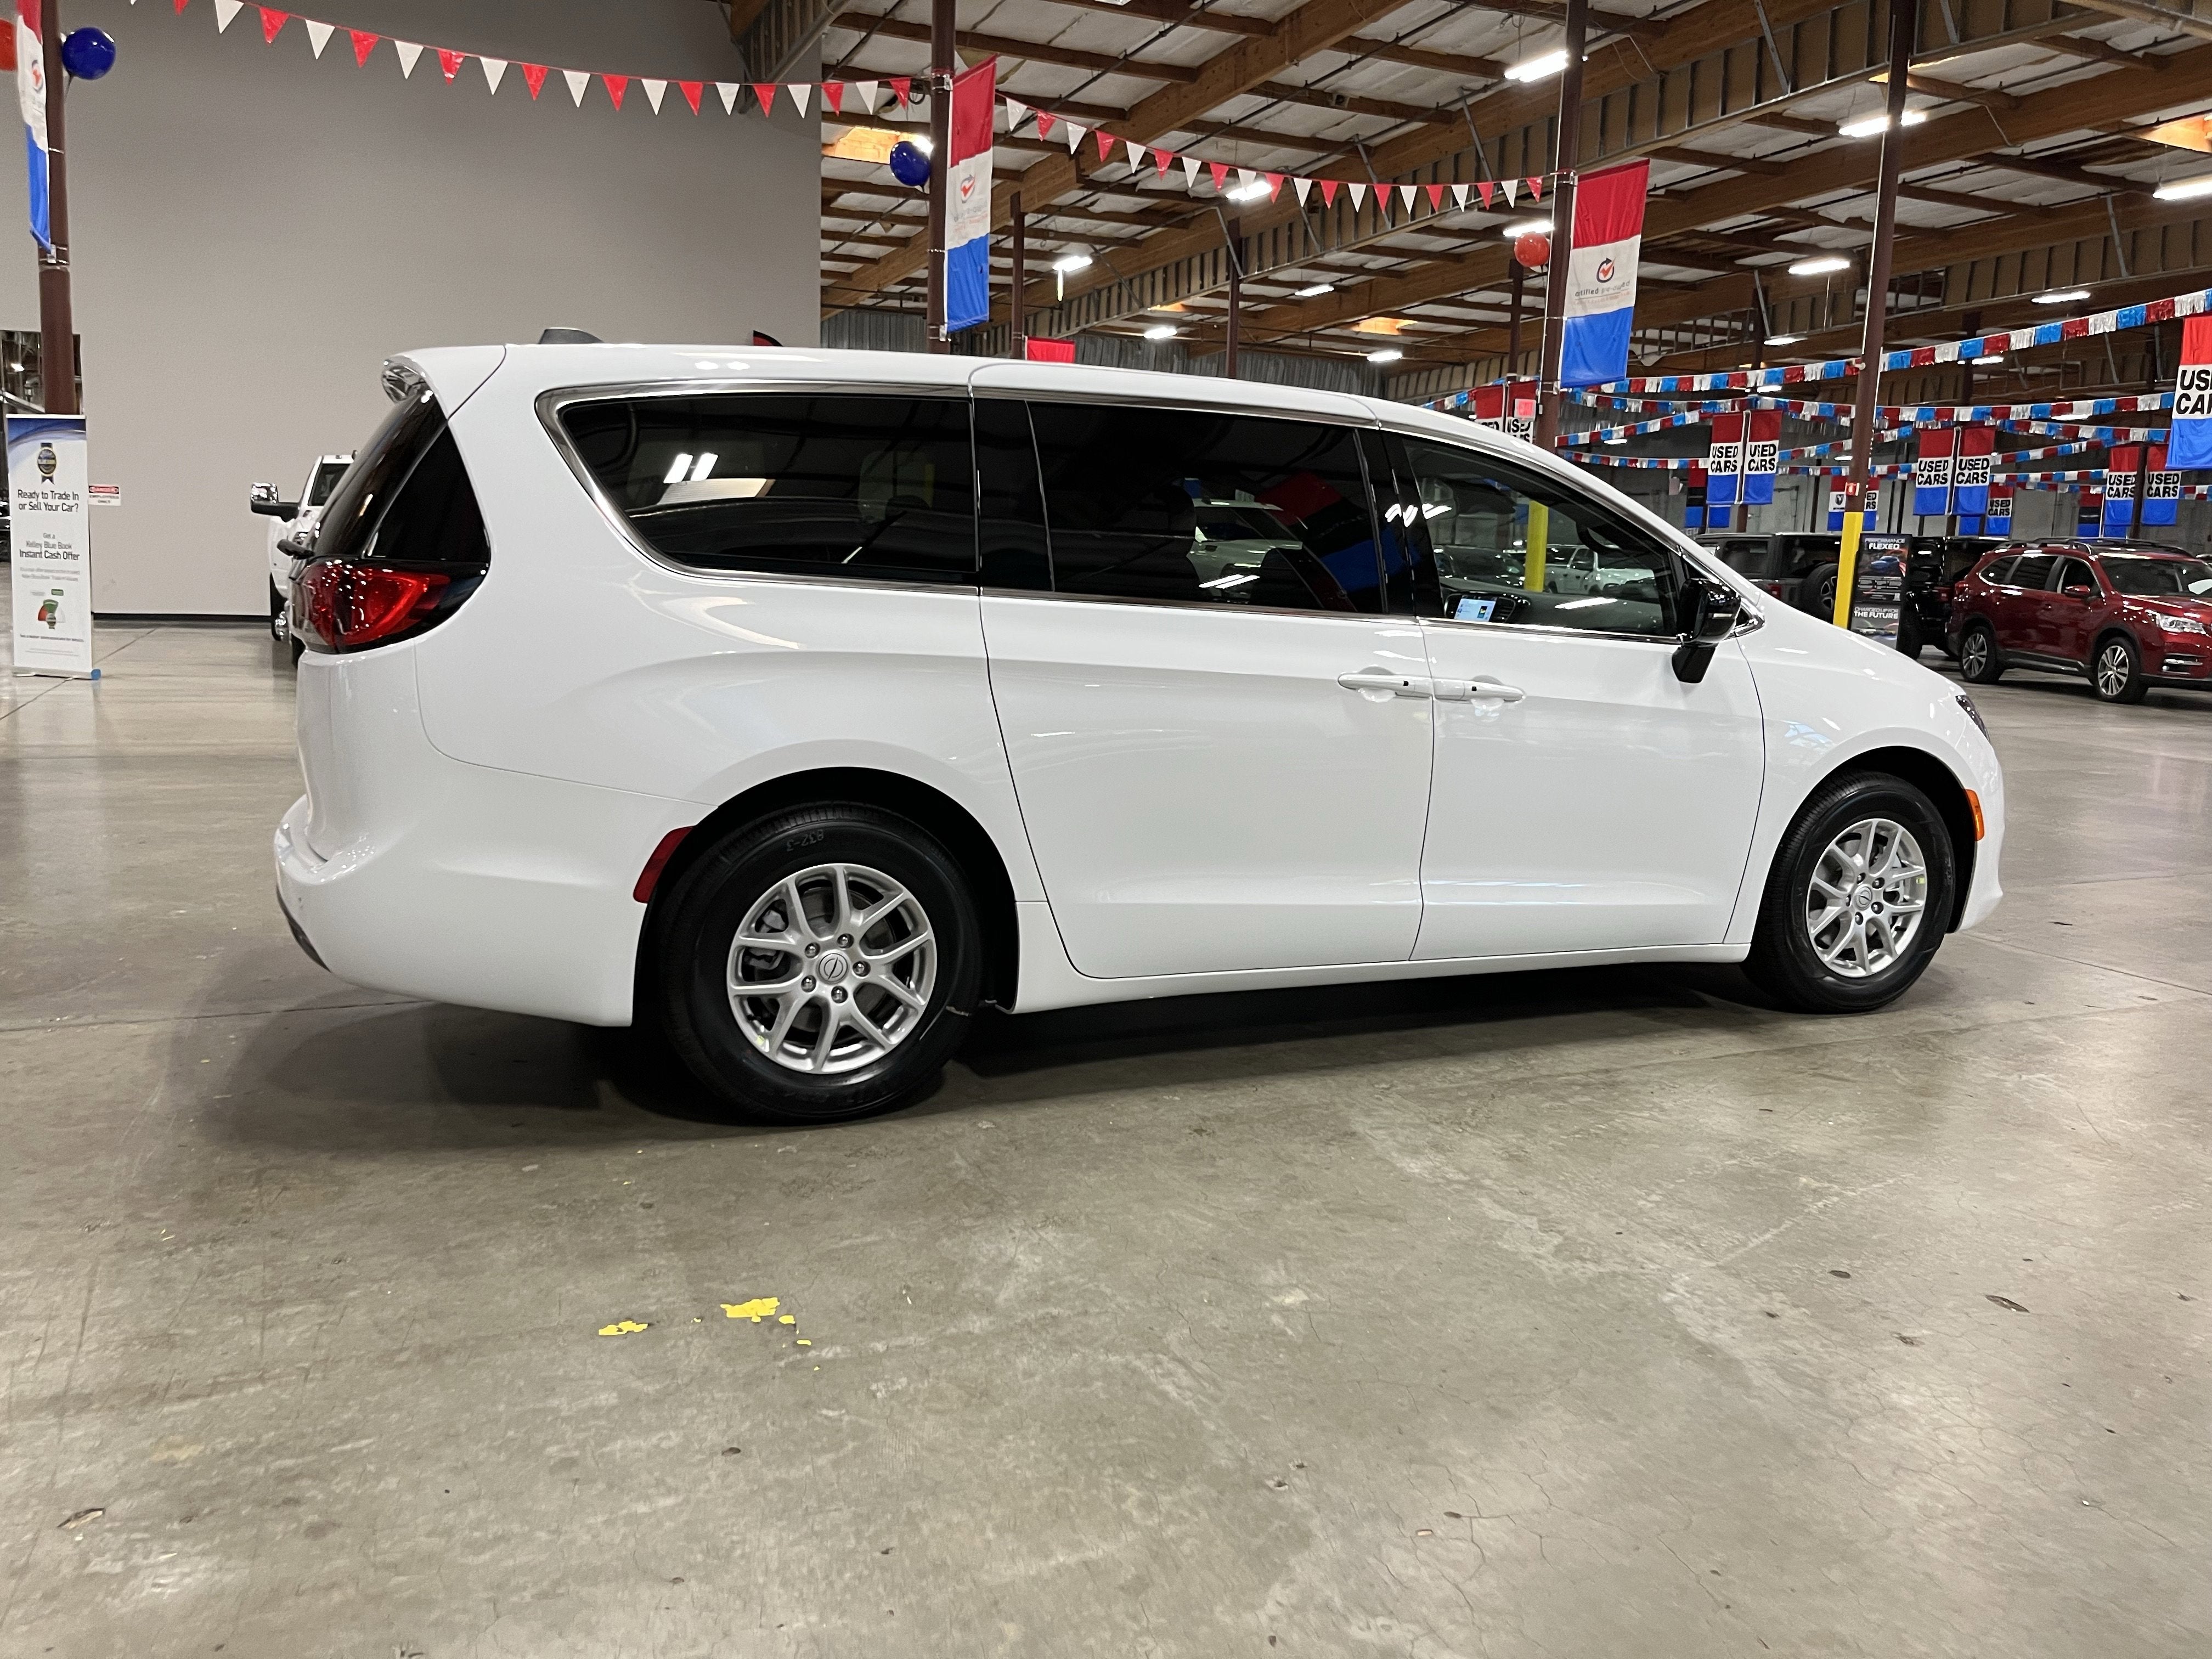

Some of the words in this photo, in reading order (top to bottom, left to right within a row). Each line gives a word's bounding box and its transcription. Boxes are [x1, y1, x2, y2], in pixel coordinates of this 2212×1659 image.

[2180, 369, 2212, 391] US
[1712, 445, 1738, 458] USED
[1711, 460, 1737, 472] CARS
[1748, 458, 1775, 471] CARS
[1918, 460, 1949, 472] USED
[1958, 458, 1990, 471] USED
[1917, 473, 1948, 485] CARS
[1956, 471, 1988, 484] CARS
[2148, 473, 2180, 485] USED
[18, 489, 40, 501] Ready
[41, 491, 48, 499] to
[50, 490, 71, 500] Trade
[72, 492, 79, 500] In
[2147, 486, 2178, 497] CARS
[29, 501, 42, 510] Sell
[43, 501, 60, 511] Your
[61, 503, 78, 512] Car?
[1988, 508, 2010, 516] CARS
[19, 549, 43, 558] Instant
[44, 550, 61, 559] Cash
[63, 551, 80, 560] Offer
